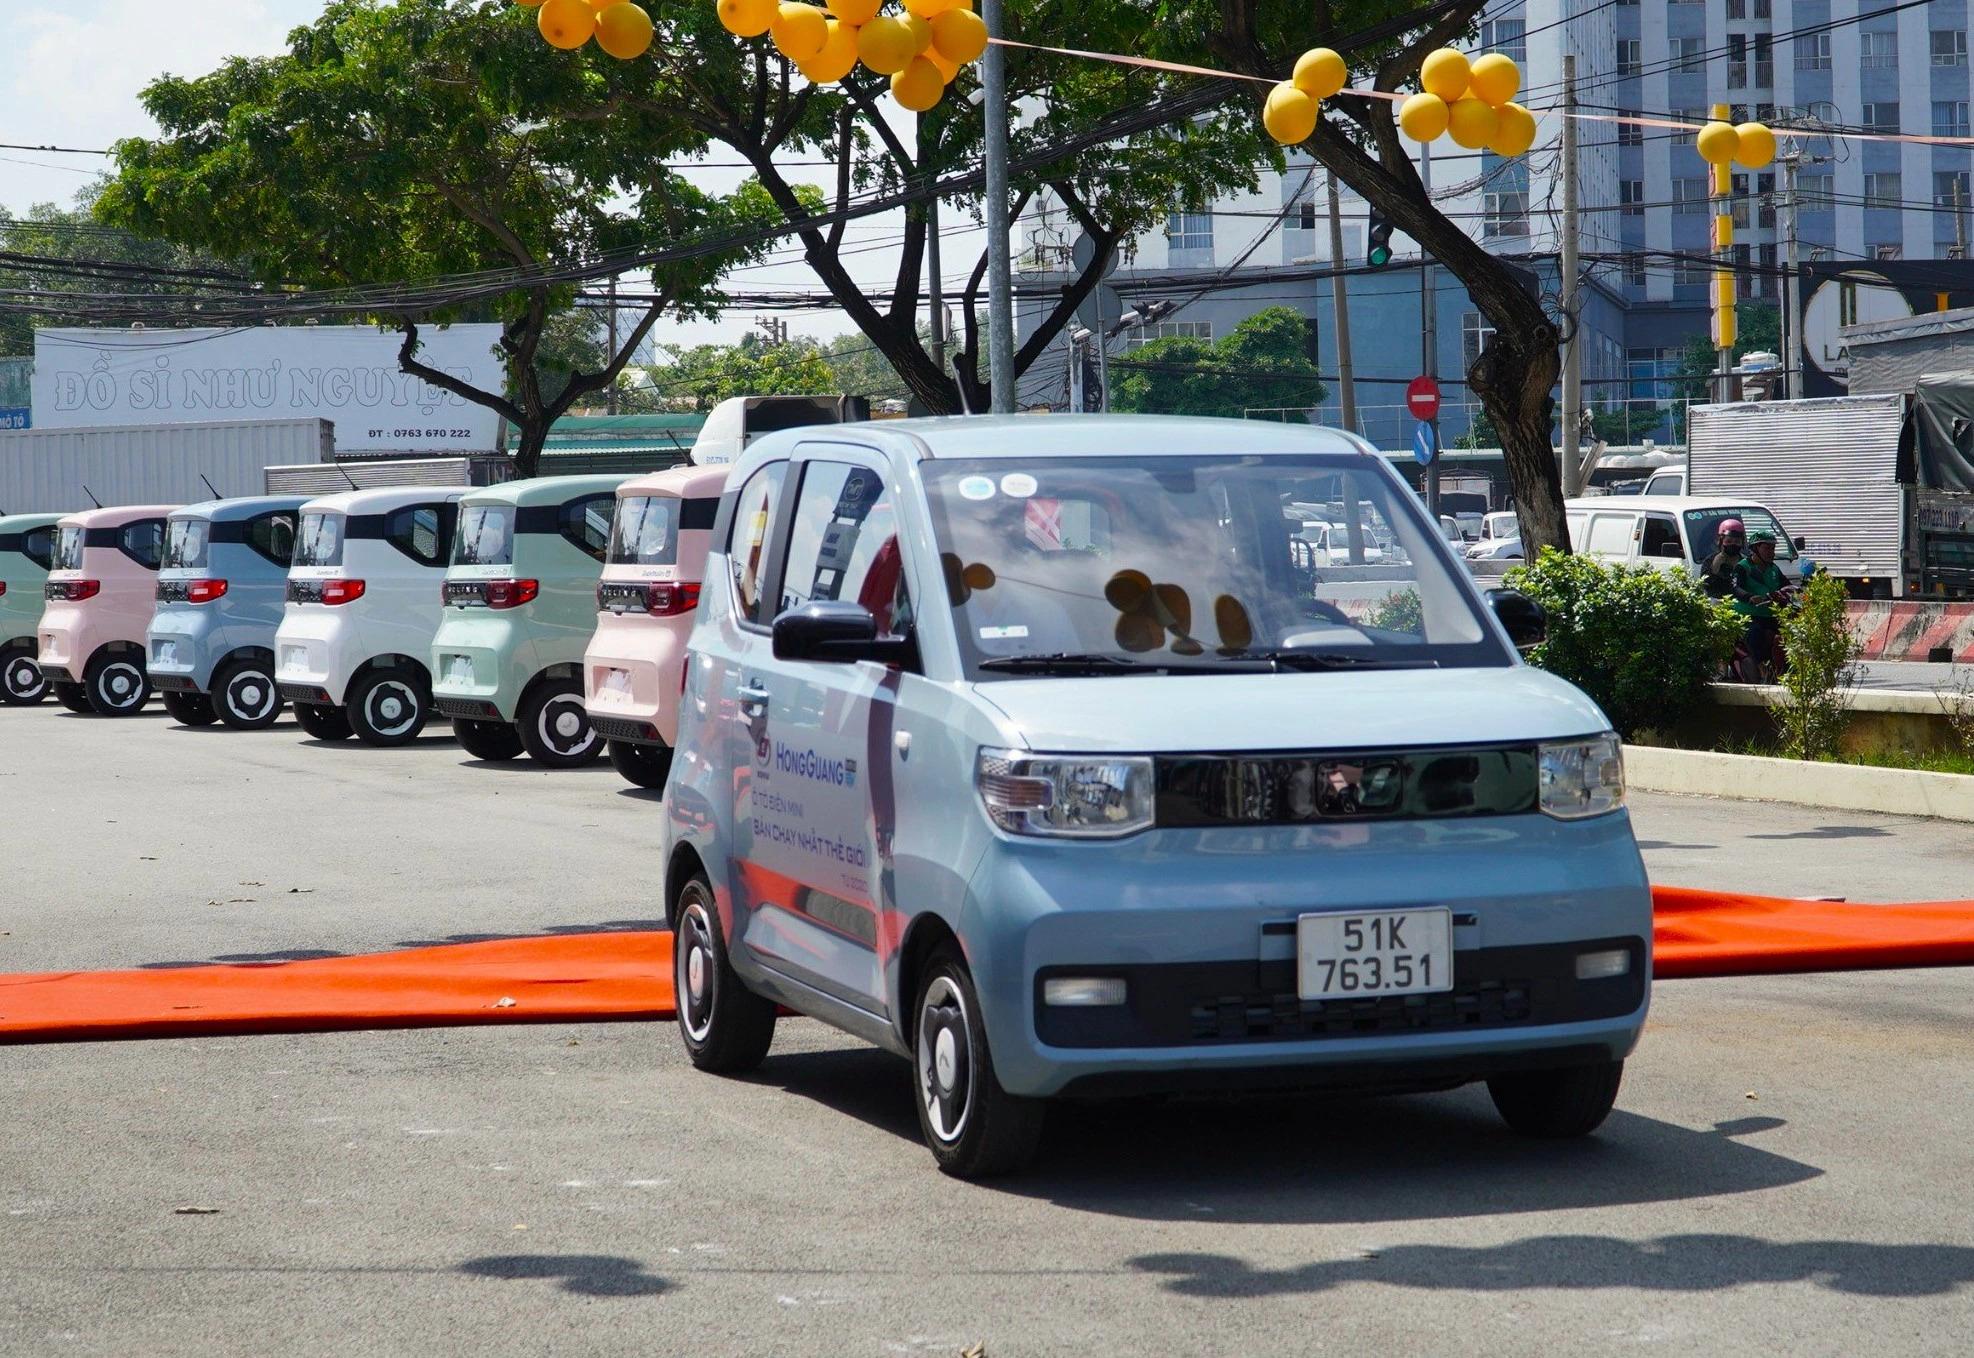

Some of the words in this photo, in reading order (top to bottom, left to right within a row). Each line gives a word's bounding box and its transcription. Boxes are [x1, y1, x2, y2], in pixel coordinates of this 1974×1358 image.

[182, 358, 282, 410] NHƯ
[368, 429, 384, 438] ĐT
[394, 429, 422, 438] 0763
[425, 429, 447, 438] 670
[450, 429, 471, 438] 222
[1344, 916, 1407, 952] 51K
[1317, 953, 1431, 993] 763.51
